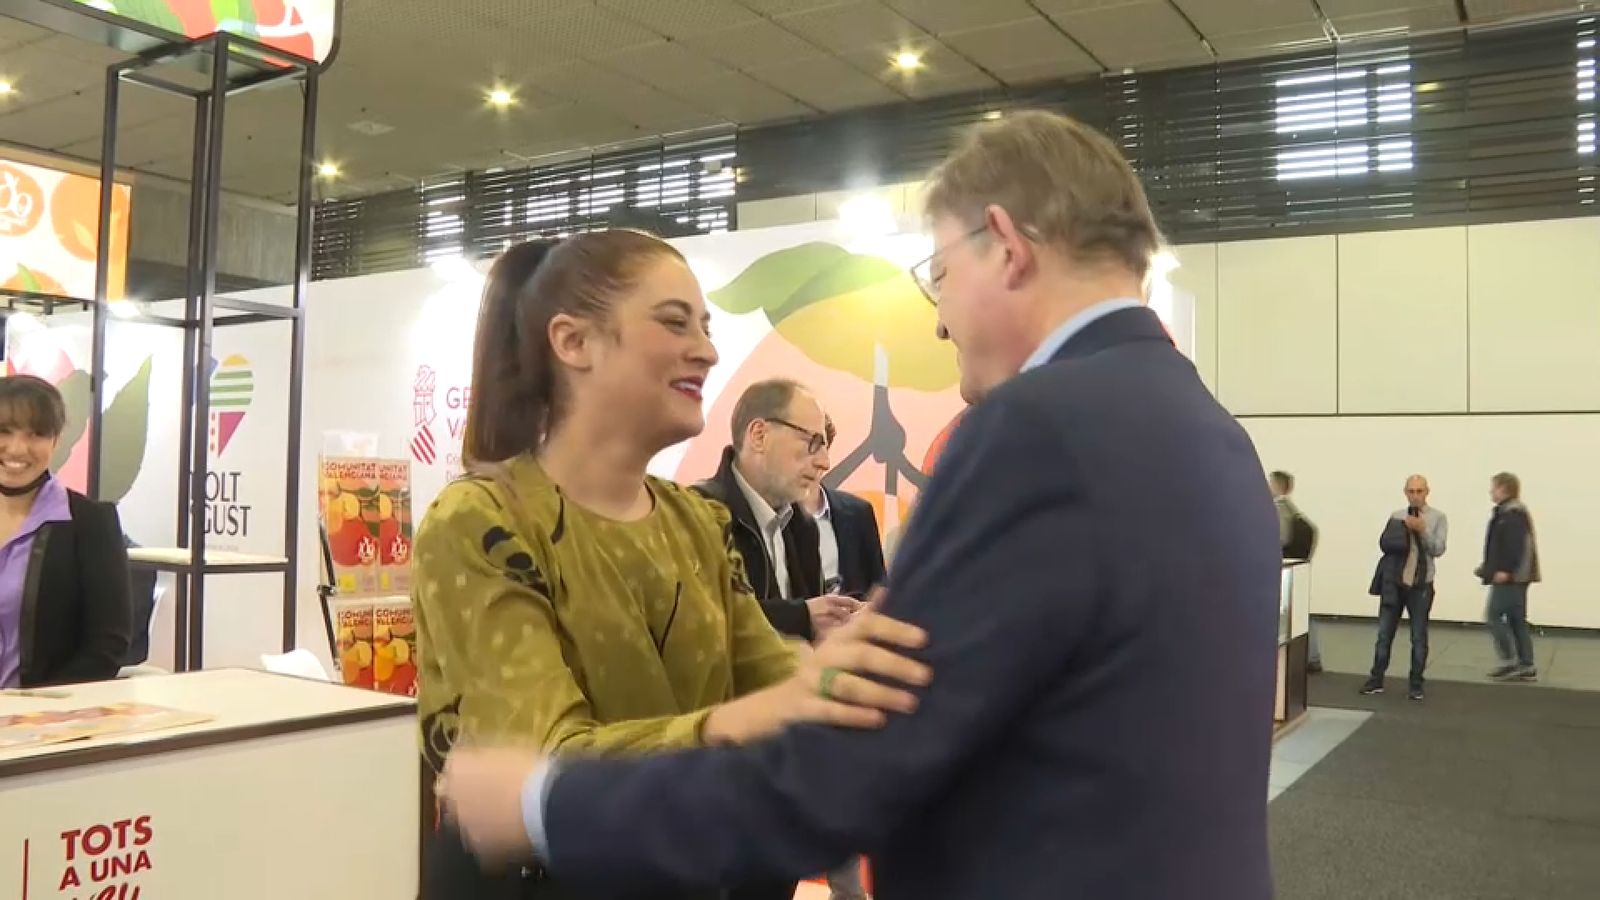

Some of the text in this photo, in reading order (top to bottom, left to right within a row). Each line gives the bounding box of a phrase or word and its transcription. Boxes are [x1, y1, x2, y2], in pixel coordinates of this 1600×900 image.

[60, 814, 153, 861] TOTS
[58, 849, 153, 891] A UNA
